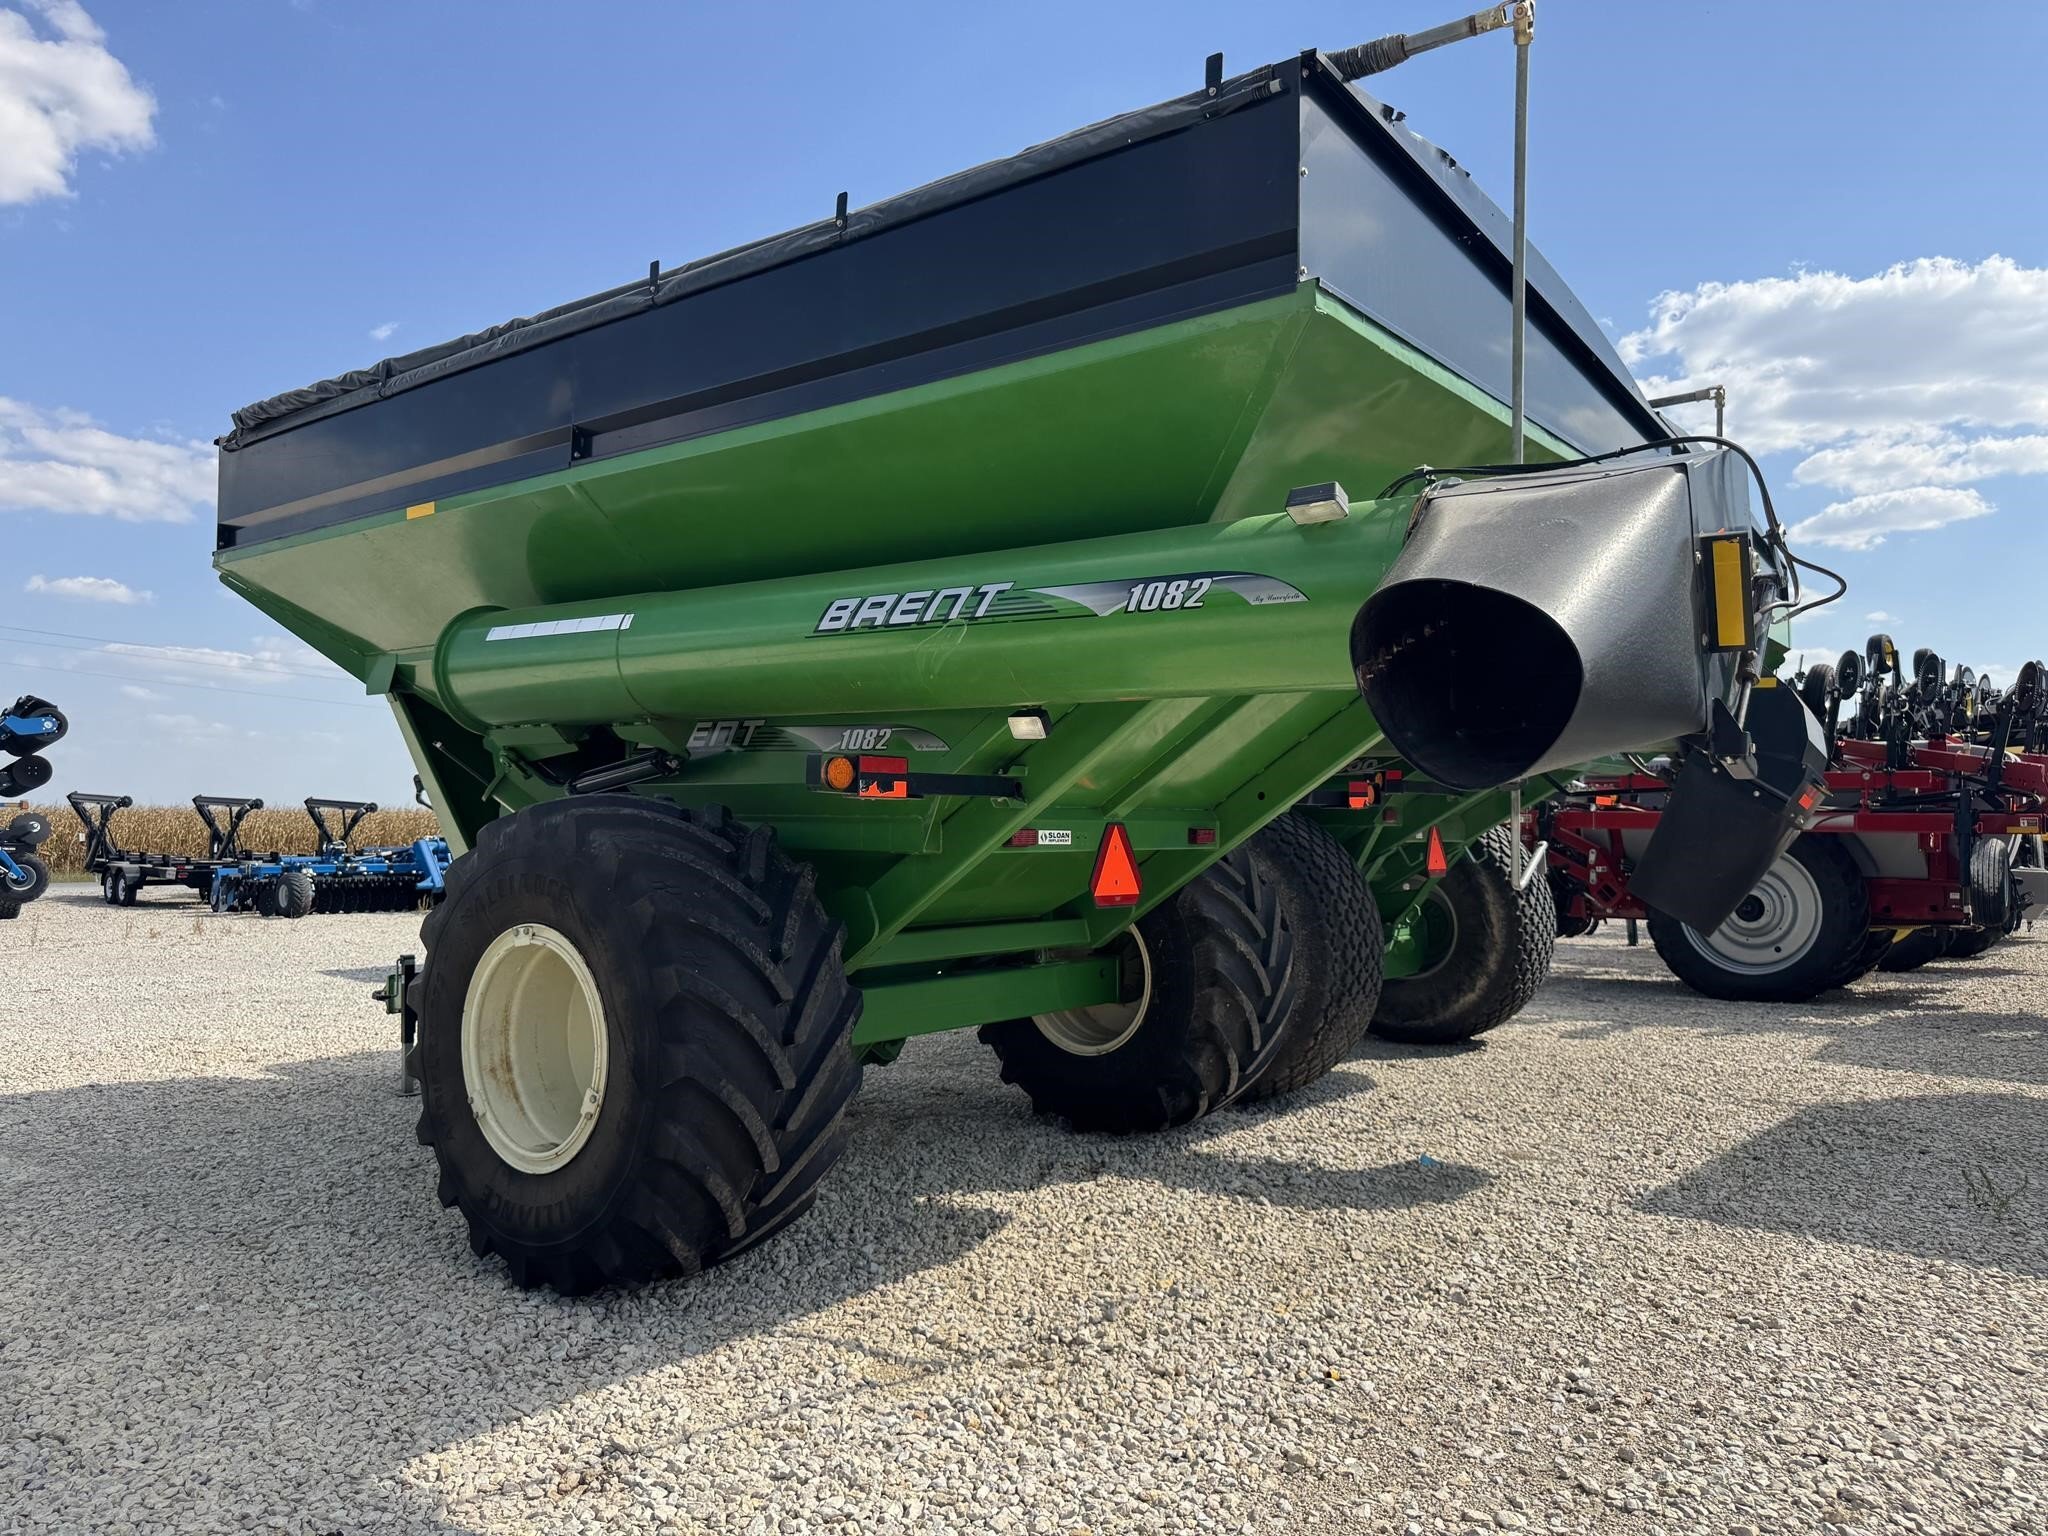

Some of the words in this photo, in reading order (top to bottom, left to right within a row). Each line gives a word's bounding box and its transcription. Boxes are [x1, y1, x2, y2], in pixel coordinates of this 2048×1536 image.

[815, 581, 1015, 632] BRENT
[1125, 578, 1212, 612] 1082
[839, 728, 892, 750] 1082
